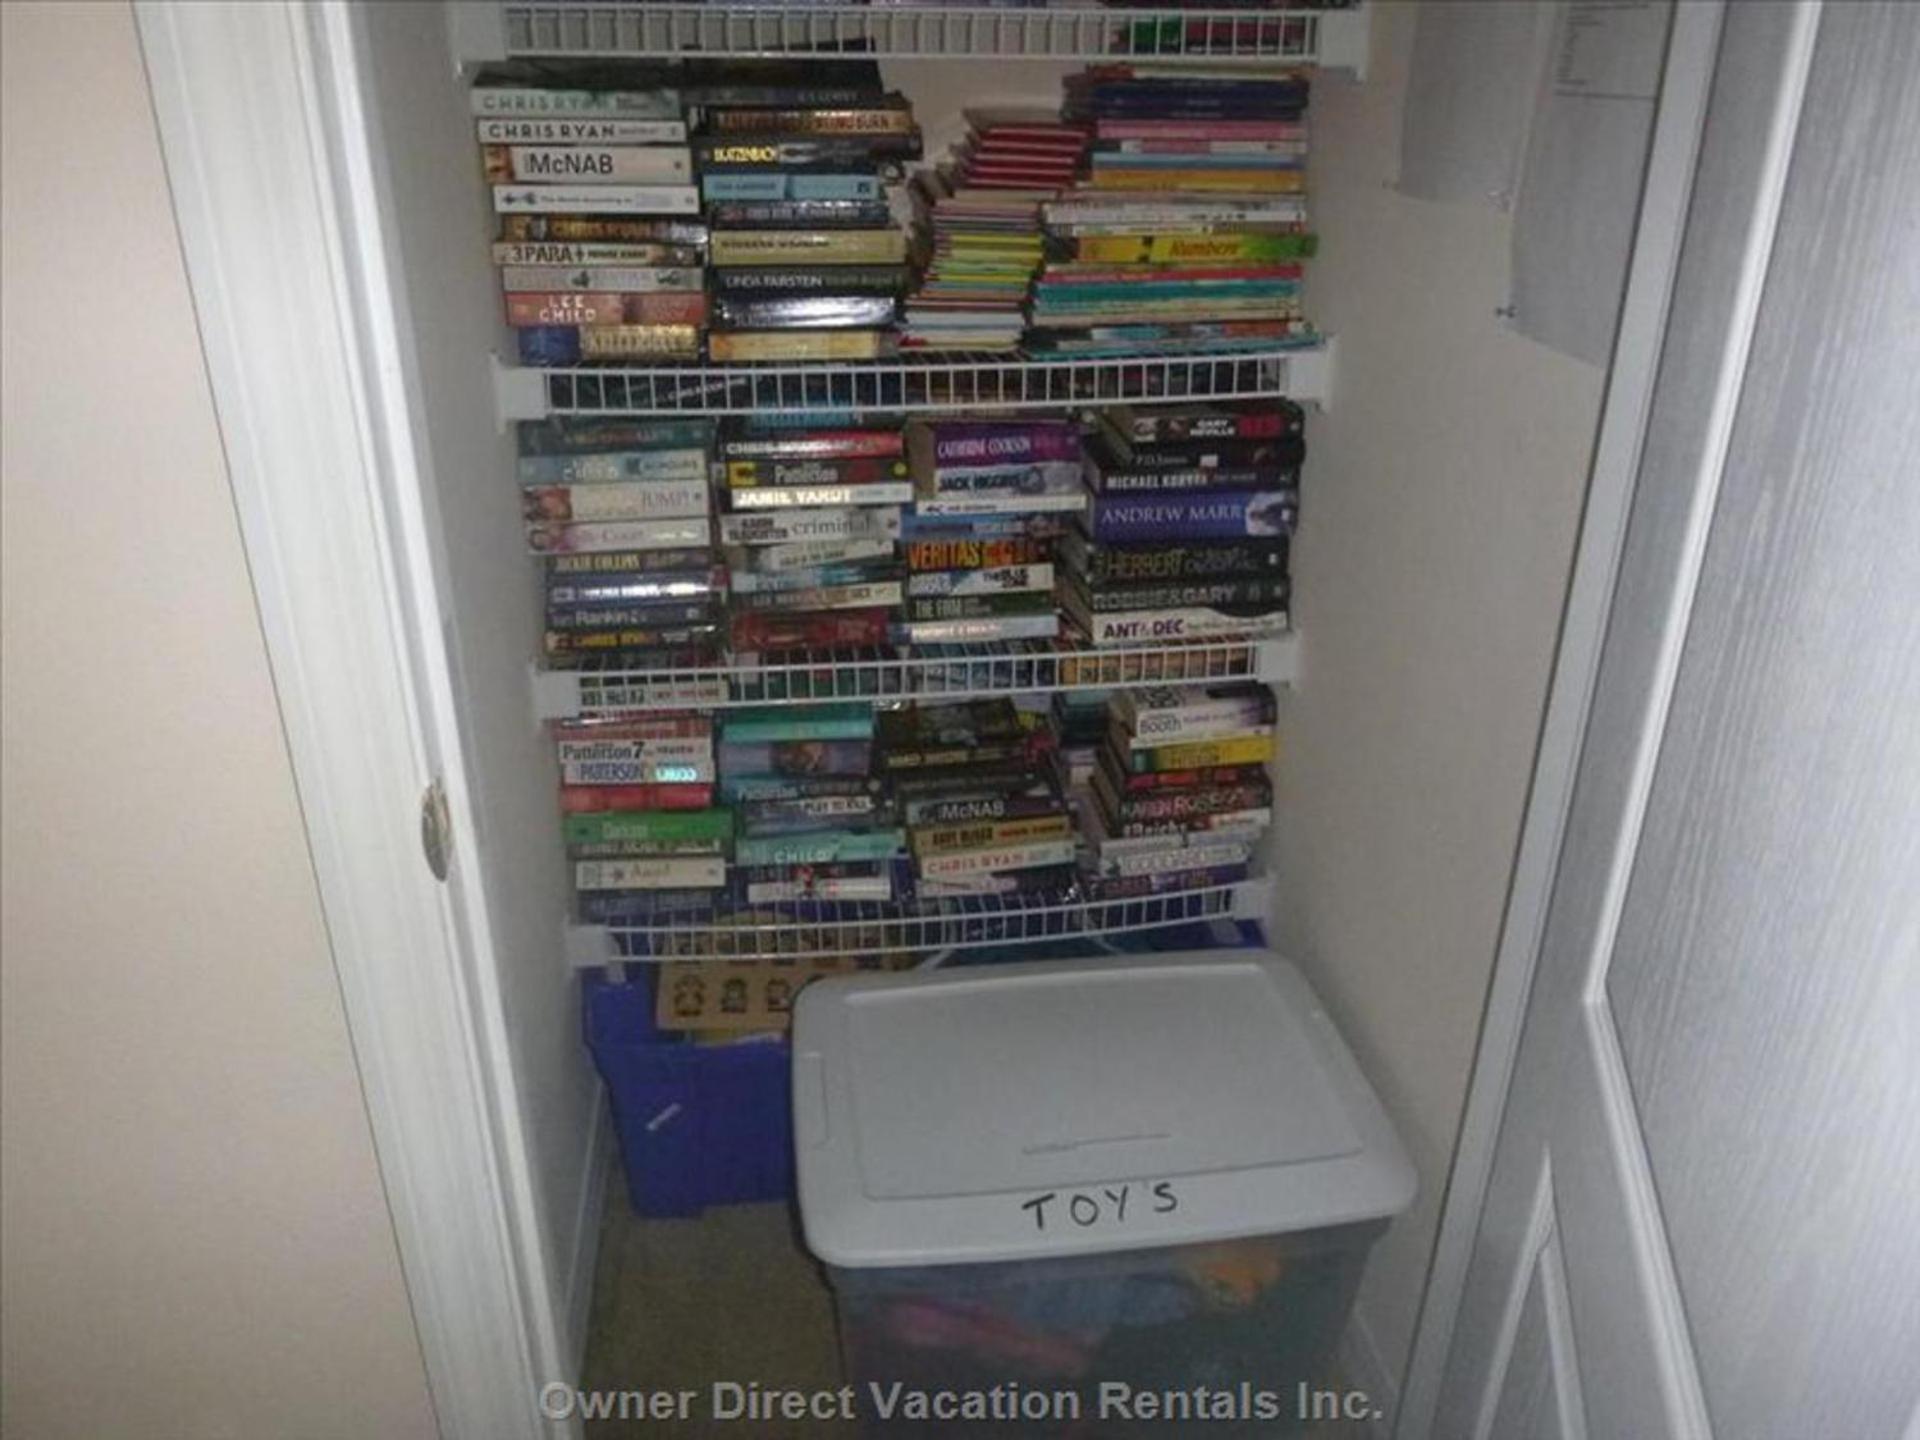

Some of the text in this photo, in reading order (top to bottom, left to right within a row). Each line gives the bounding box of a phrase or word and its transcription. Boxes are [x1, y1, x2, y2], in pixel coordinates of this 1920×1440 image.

[488, 123, 554, 139] CHRIS
[560, 123, 615, 138] RYAN
[529, 152, 614, 175] McNAB
[1106, 474, 1159, 490] MICHAEL
[792, 513, 870, 535] criminal
[1102, 503, 1242, 524] ANDREW MARR
[910, 539, 981, 570] VERITAS
[1104, 621, 1143, 639] ANT
[1152, 618, 1184, 635] DEC
[632, 741, 645, 759] 7
[927, 855, 976, 874] CHRIS
